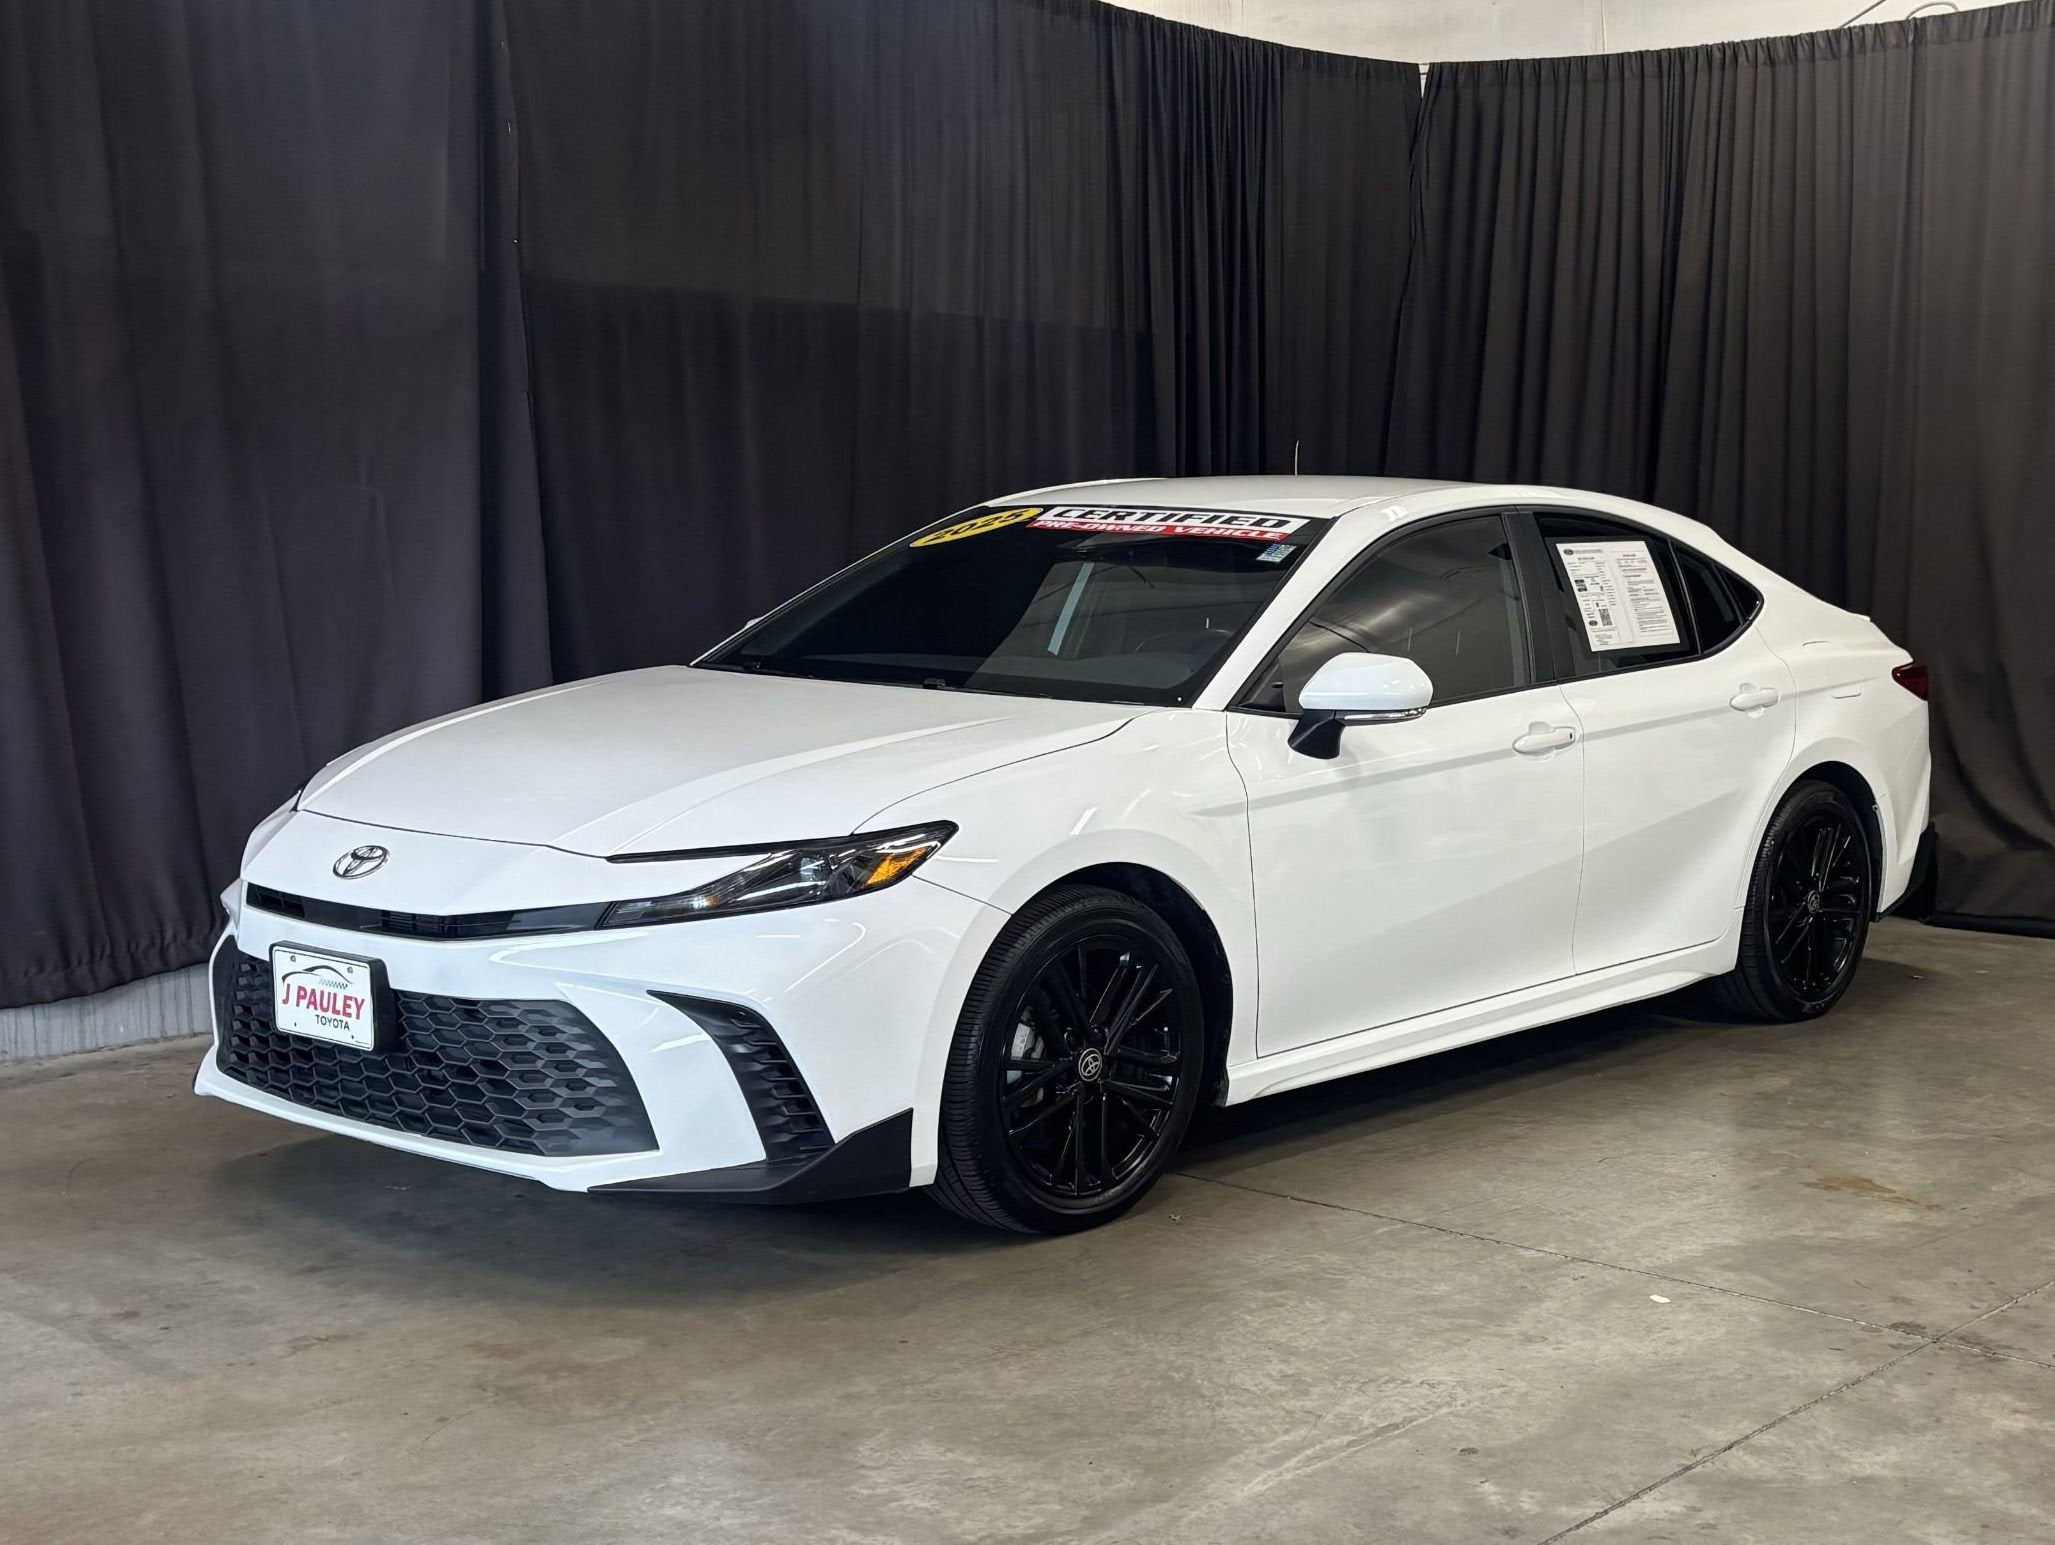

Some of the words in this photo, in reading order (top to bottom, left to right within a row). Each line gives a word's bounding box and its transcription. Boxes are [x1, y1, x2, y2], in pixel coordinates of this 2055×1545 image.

[922, 509, 1030, 543] 2025
[1053, 508, 1291, 528] CERTIFIED
[1034, 520, 1163, 532] PRE-OWNED
[1174, 525, 1283, 539] VEHICLE
[282, 983, 290, 1004] J
[296, 985, 365, 1020] PAULEY
[315, 1014, 350, 1031] TOYOTA
